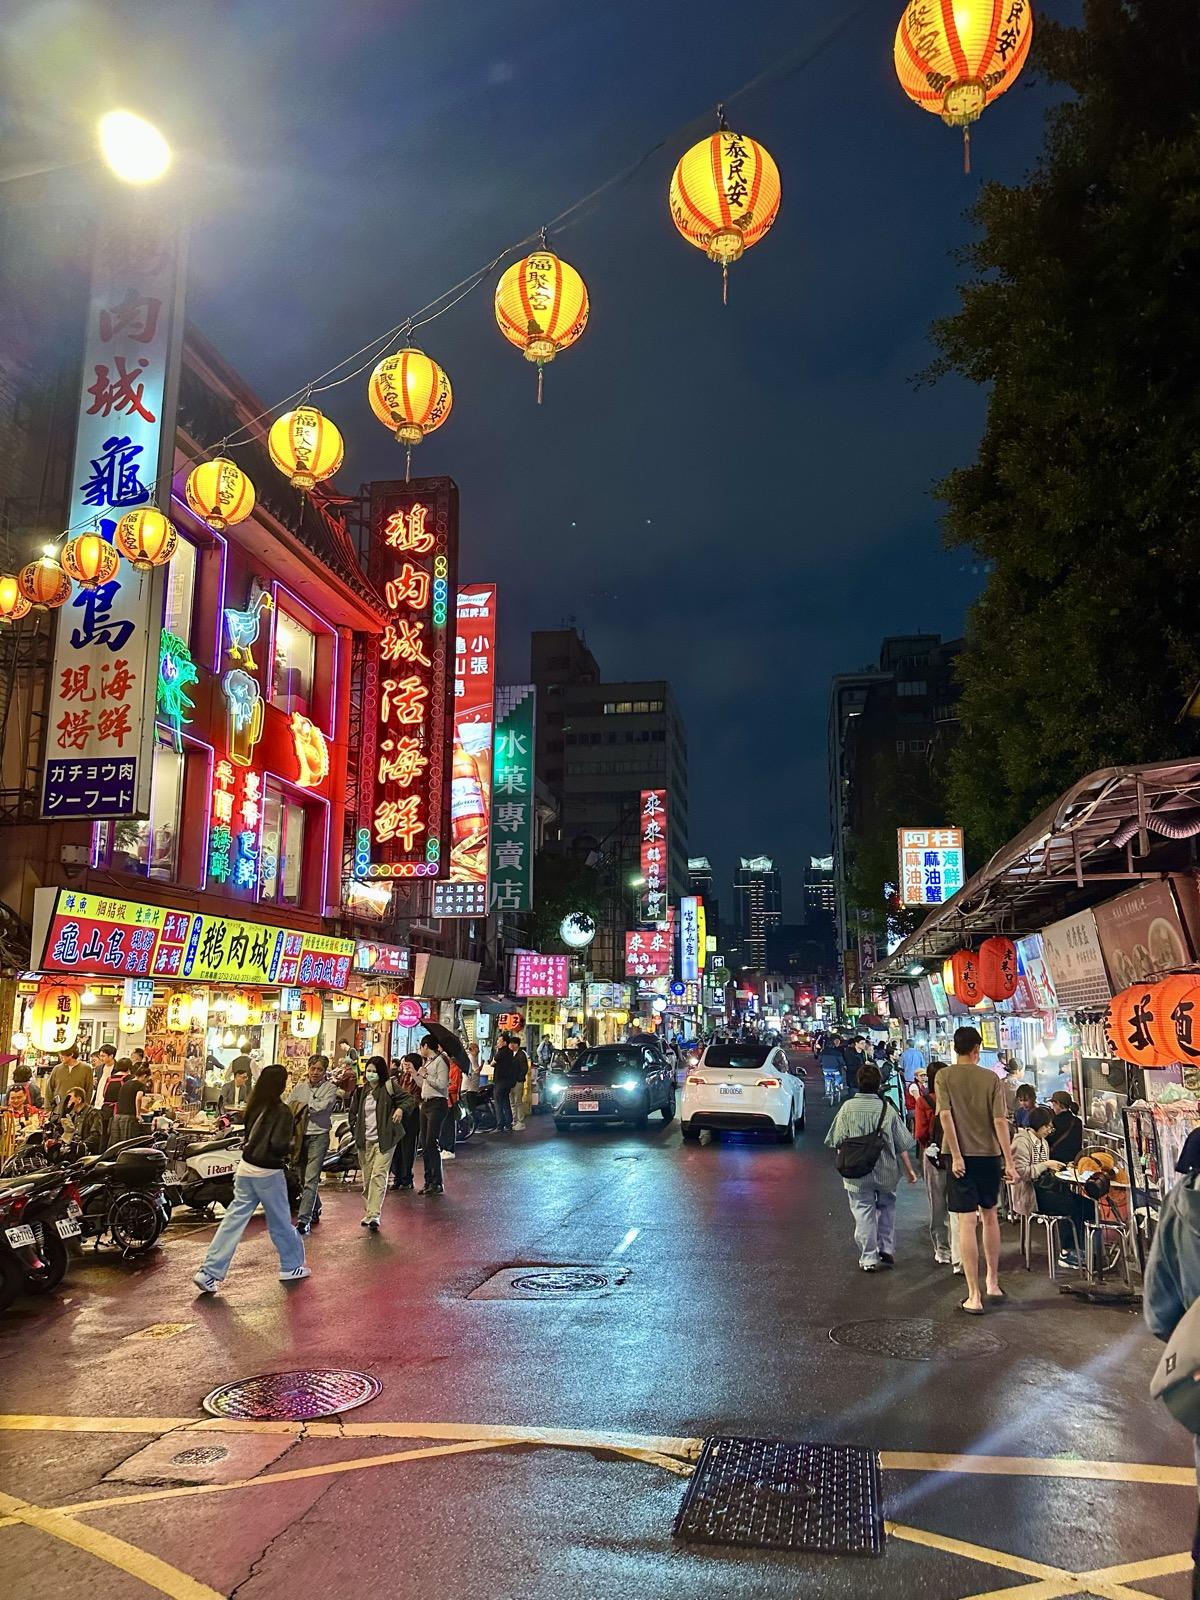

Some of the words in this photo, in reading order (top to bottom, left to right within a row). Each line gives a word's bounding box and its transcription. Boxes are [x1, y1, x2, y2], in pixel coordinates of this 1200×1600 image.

[373, 502, 437, 854] 鵝肉城活海鮮
[469, 634, 490, 675] 小張
[56, 663, 97, 750] 現撈
[97, 659, 137, 748] 海鮮
[50, 763, 134, 783] ガチョウ肉
[48, 790, 132, 808] シーフード
[491, 730, 528, 912] 水菓專賣店
[52, 922, 126, 968] 龜山島
[163, 915, 188, 940] 平價
[200, 920, 272, 975] 鵝肉城
[54, 994, 71, 1044] 龜山島
